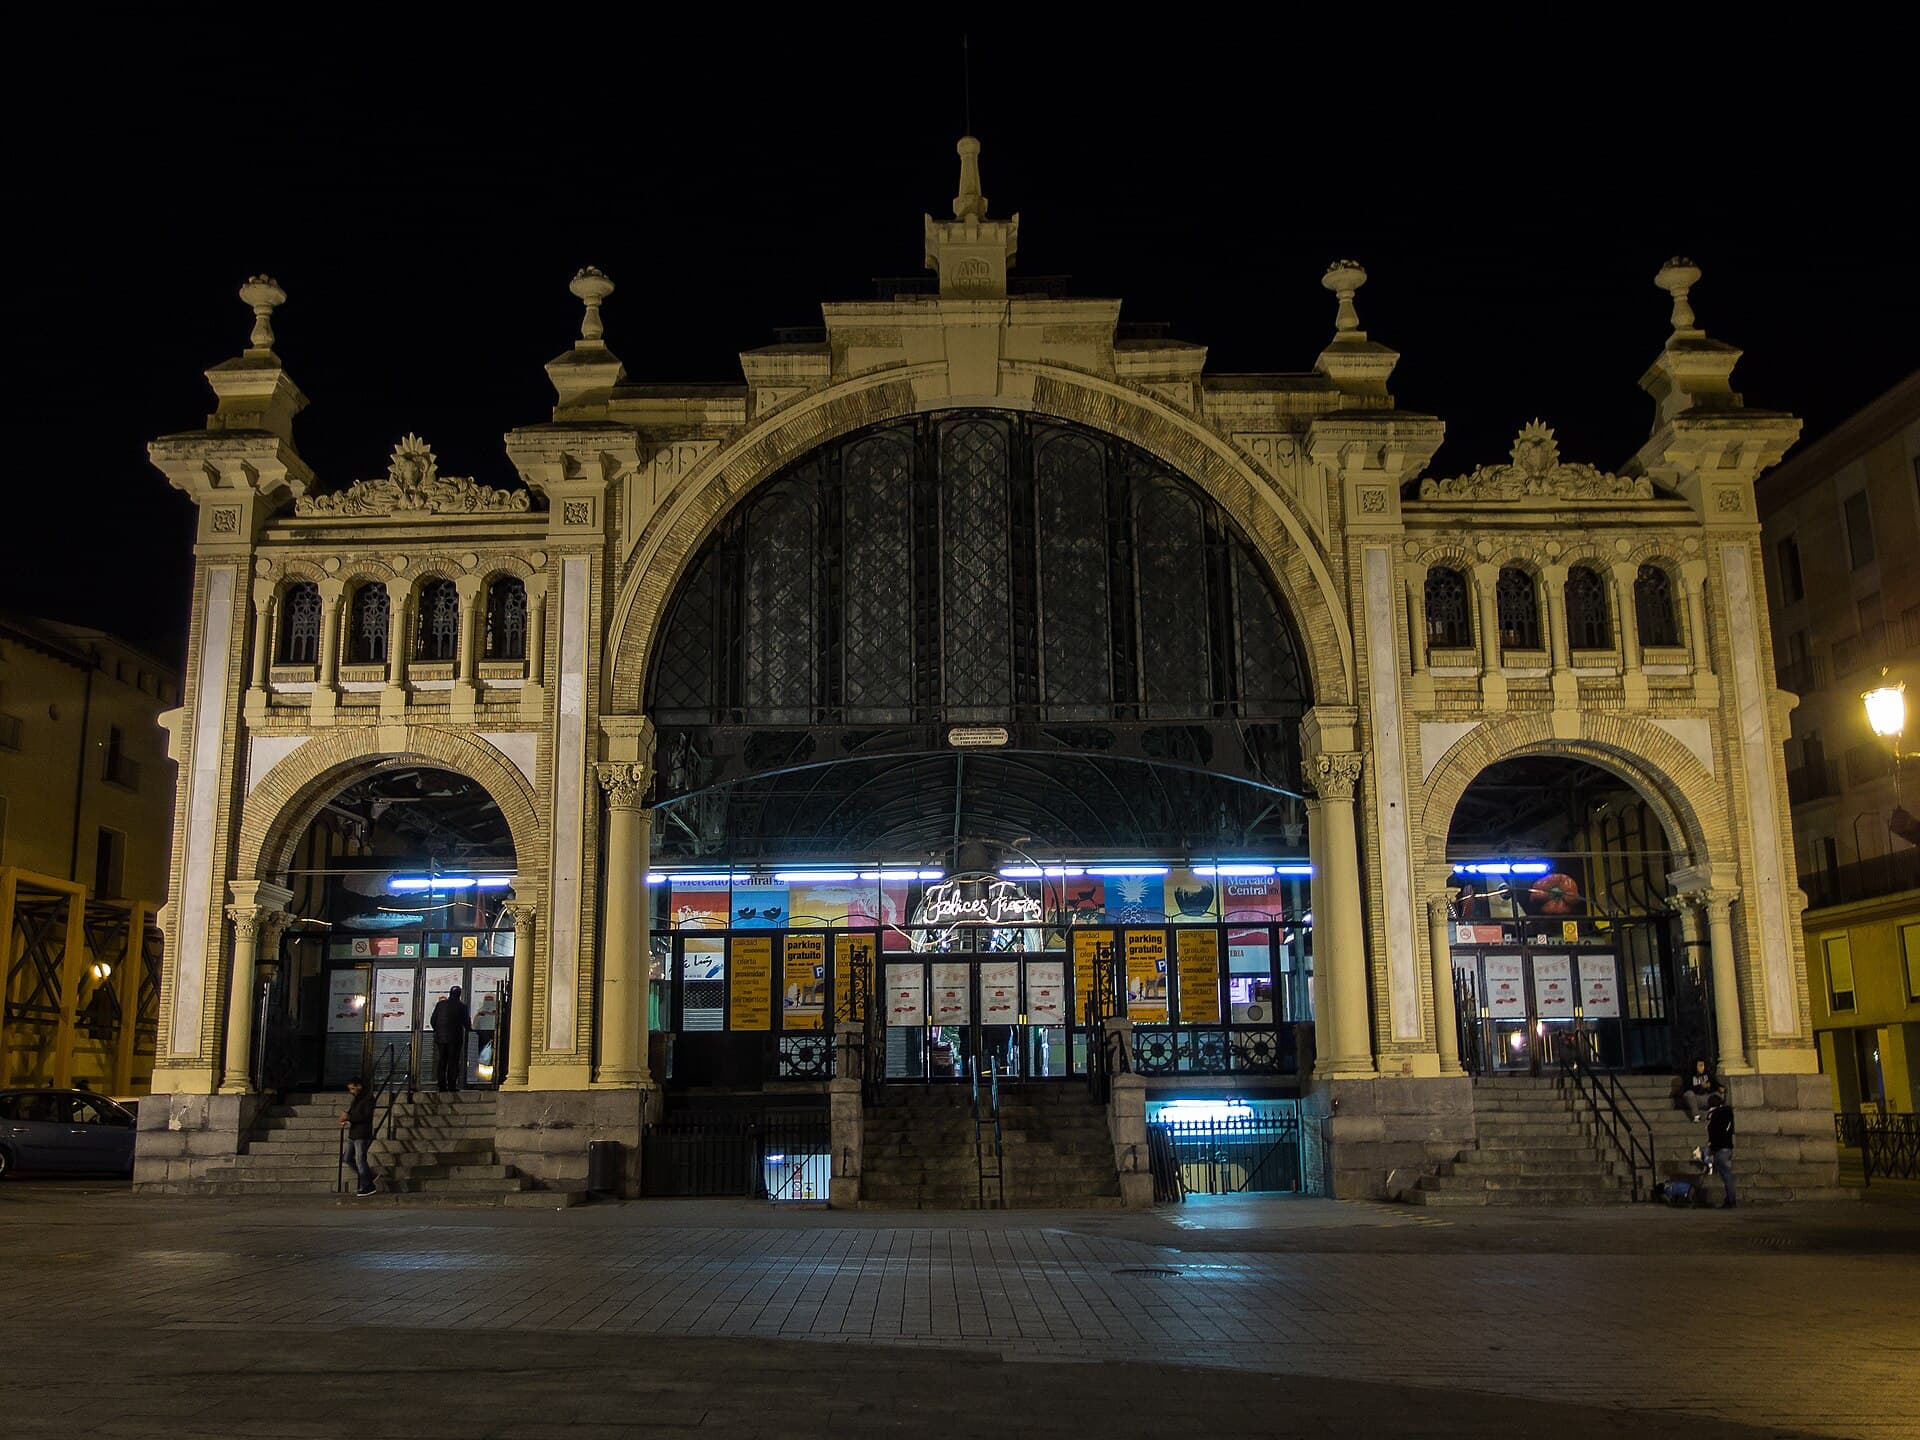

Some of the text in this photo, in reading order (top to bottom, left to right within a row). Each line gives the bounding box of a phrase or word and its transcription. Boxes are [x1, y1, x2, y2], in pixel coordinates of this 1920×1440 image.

[1228, 876, 1274, 886] Mercado
[1228, 885, 1267, 896] Central
[923, 880, 1042, 923] Felices Fiestas
[1129, 935, 1163, 945] parking
[787, 940, 821, 951] parking
[1129, 945, 1163, 955] gratuito
[787, 951, 821, 961] gratuito
